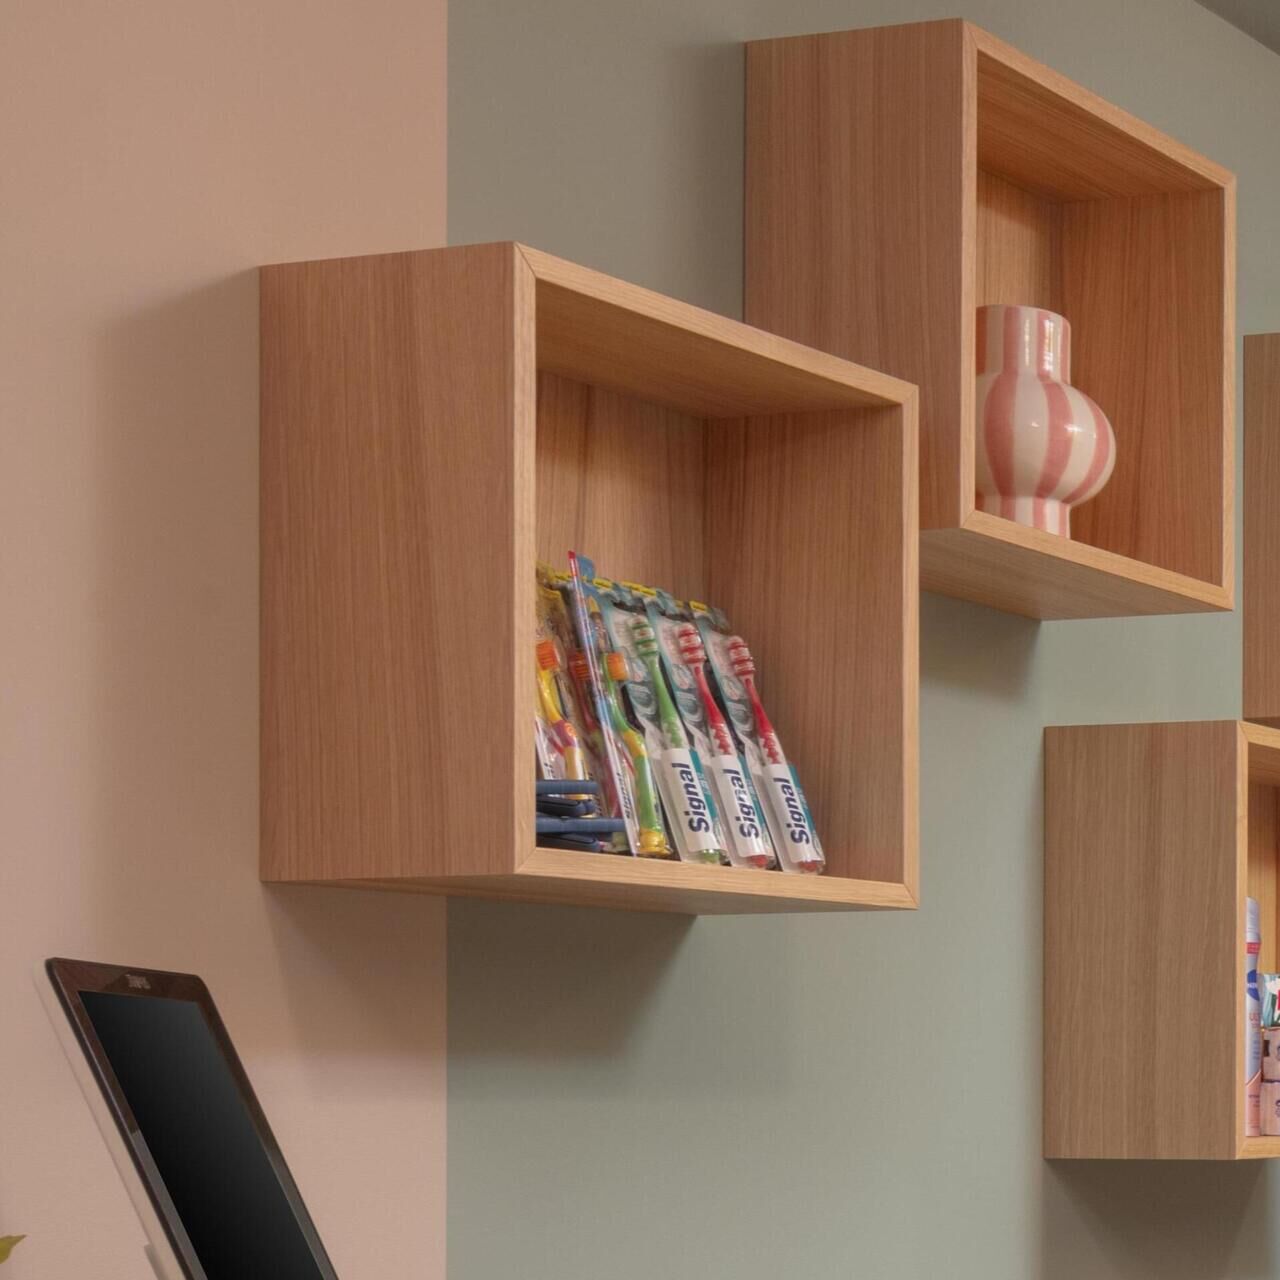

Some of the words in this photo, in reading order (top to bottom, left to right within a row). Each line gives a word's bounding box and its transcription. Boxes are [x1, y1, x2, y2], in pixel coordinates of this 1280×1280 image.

[672, 762, 709, 833] Signal
[723, 768, 760, 839] Signal
[773, 777, 810, 845] Signal
